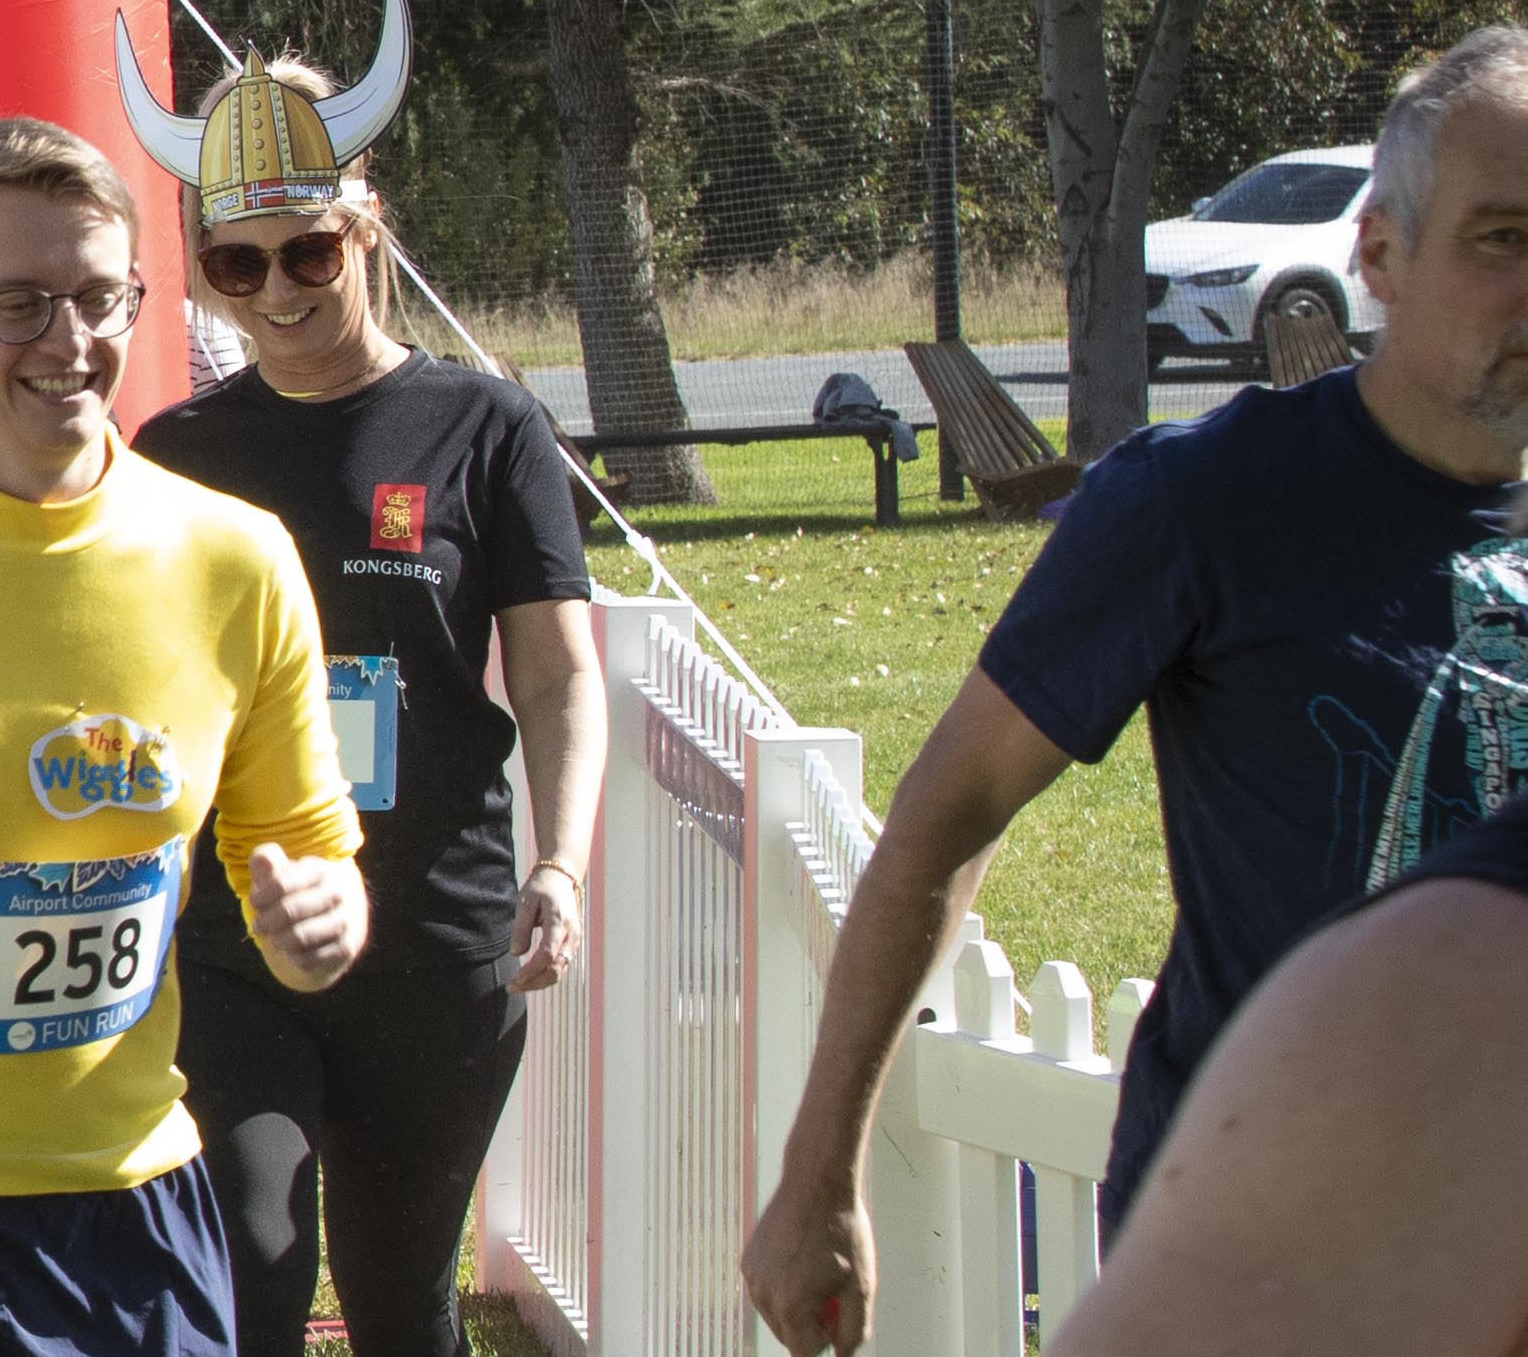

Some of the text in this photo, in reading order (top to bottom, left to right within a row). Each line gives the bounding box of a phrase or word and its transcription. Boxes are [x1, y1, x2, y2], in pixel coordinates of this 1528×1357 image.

[287, 184, 334, 199] NORWAY
[343, 559, 442, 585] KONGSBERG
[84, 727, 123, 752] The
[33, 749, 174, 803] Wiggles
[9, 883, 152, 914] Airport Community
[14, 917, 141, 1005] 258
[41, 1001, 134, 1044] FUN RUN
